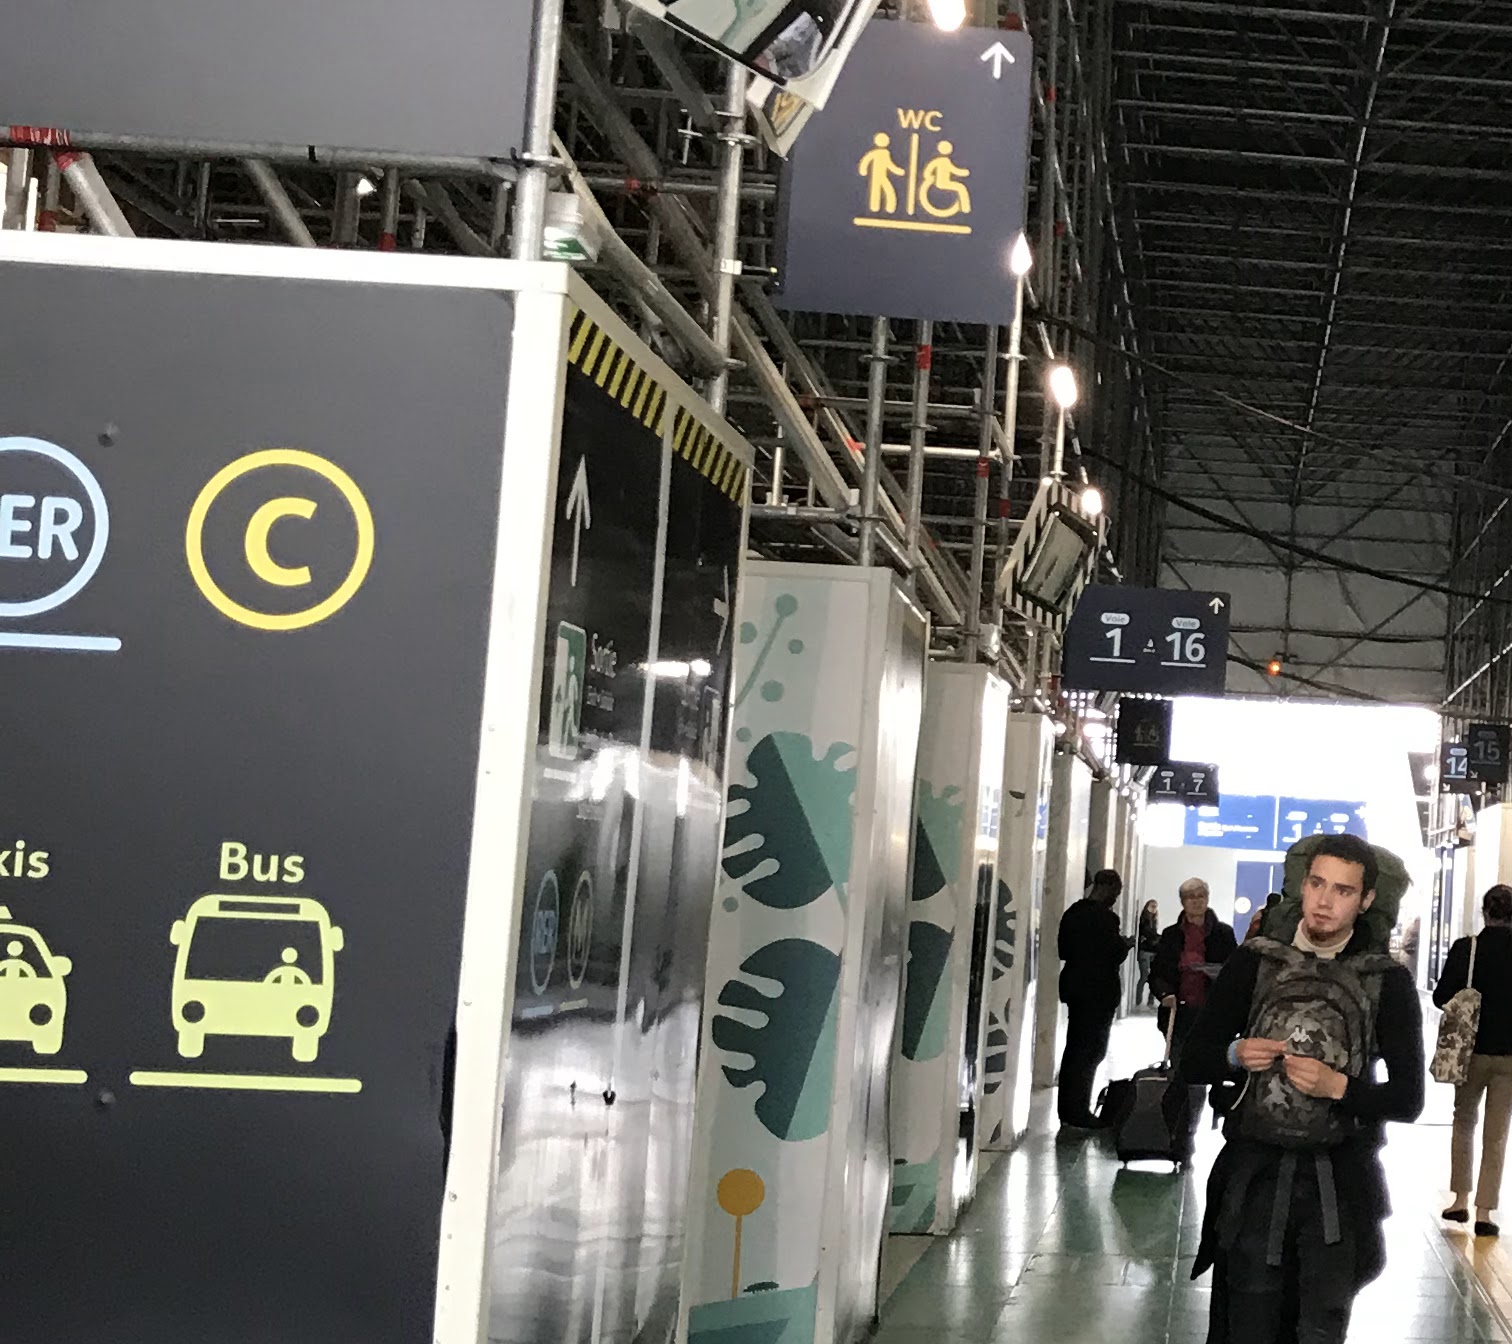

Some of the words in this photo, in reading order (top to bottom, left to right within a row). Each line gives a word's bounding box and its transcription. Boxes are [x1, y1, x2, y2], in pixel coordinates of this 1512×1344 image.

[896, 107, 943, 132] WC
[245, 496, 318, 587] C
[1106, 627, 1122, 657] 1
[1165, 631, 1206, 662] 16
[1473, 740, 1500, 761] 15
[1446, 756, 1468, 775] 14
[1163, 777, 1171, 791] 1
[1193, 779, 1203, 792] 7
[219, 841, 305, 884] Bus
